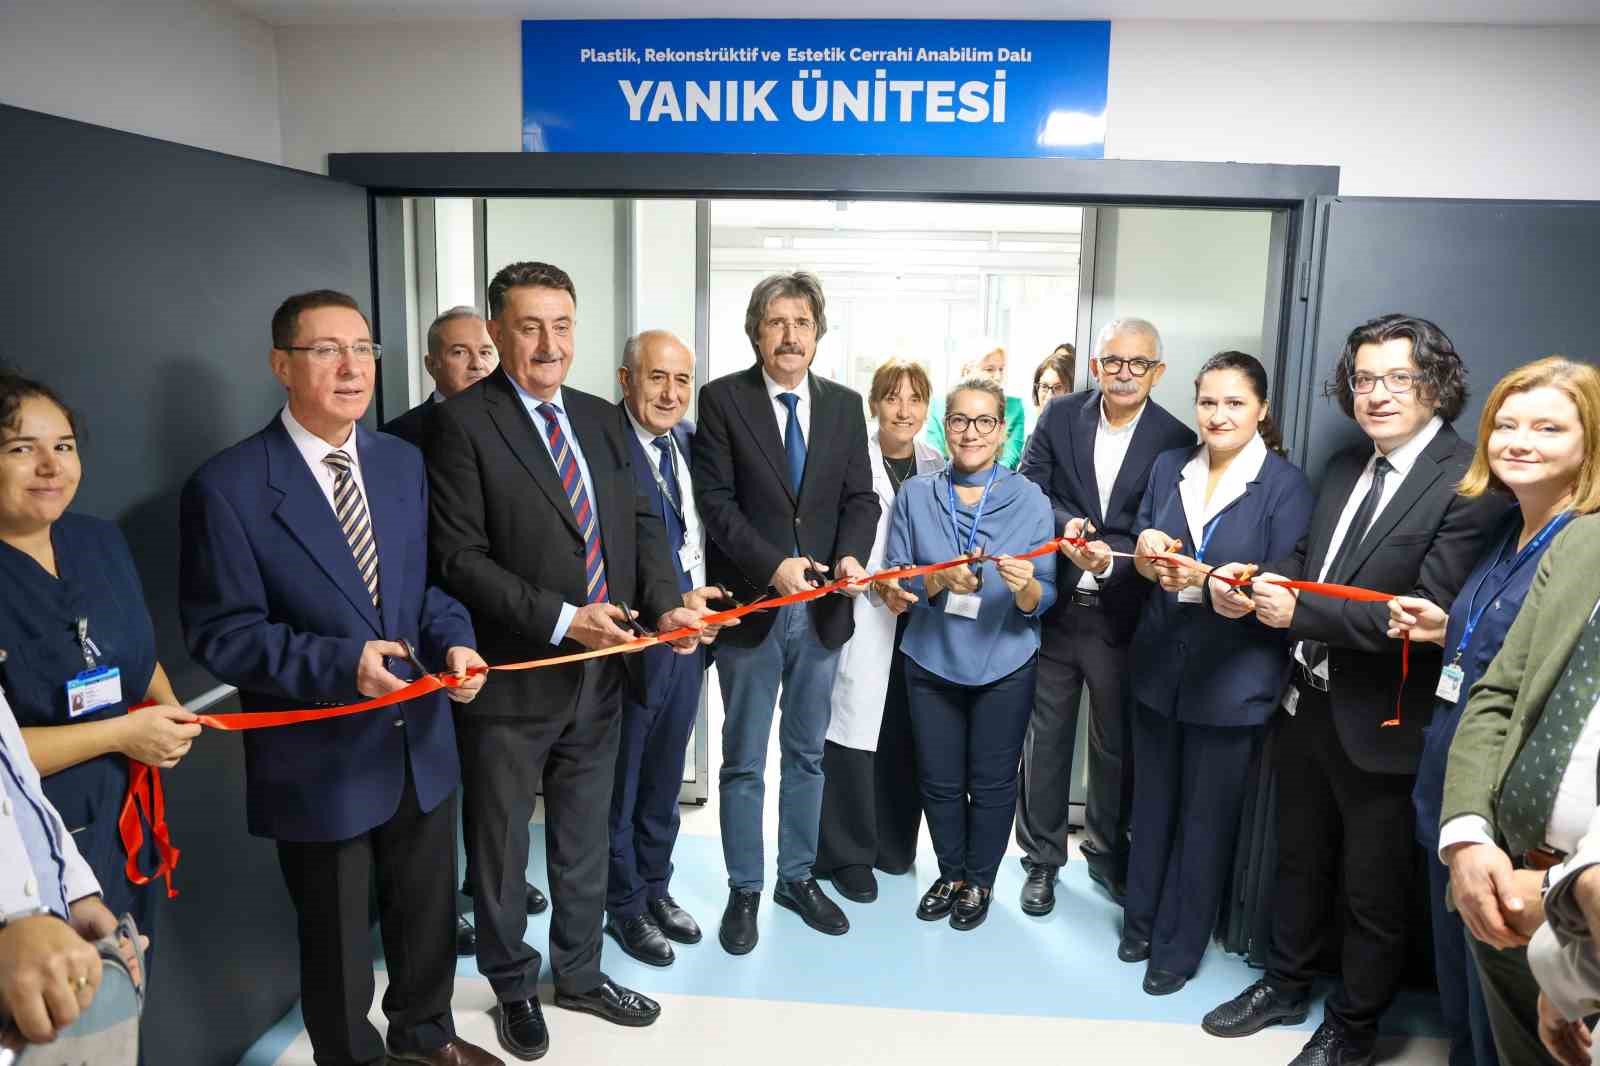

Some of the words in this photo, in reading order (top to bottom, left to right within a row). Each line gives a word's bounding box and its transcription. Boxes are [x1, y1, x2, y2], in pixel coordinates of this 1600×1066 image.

[580, 47, 641, 64] Plastik,
[645, 47, 759, 63] Rekonstrüktif
[761, 51, 782, 63] ve
[787, 47, 845, 62] Estetik
[849, 47, 913, 62] Cerrahi
[916, 47, 993, 62] Anabilim
[997, 47, 1032, 62] Dalı
[618, 80, 778, 122] YANIK
[791, 69, 1006, 123] ÜNİTESİ
